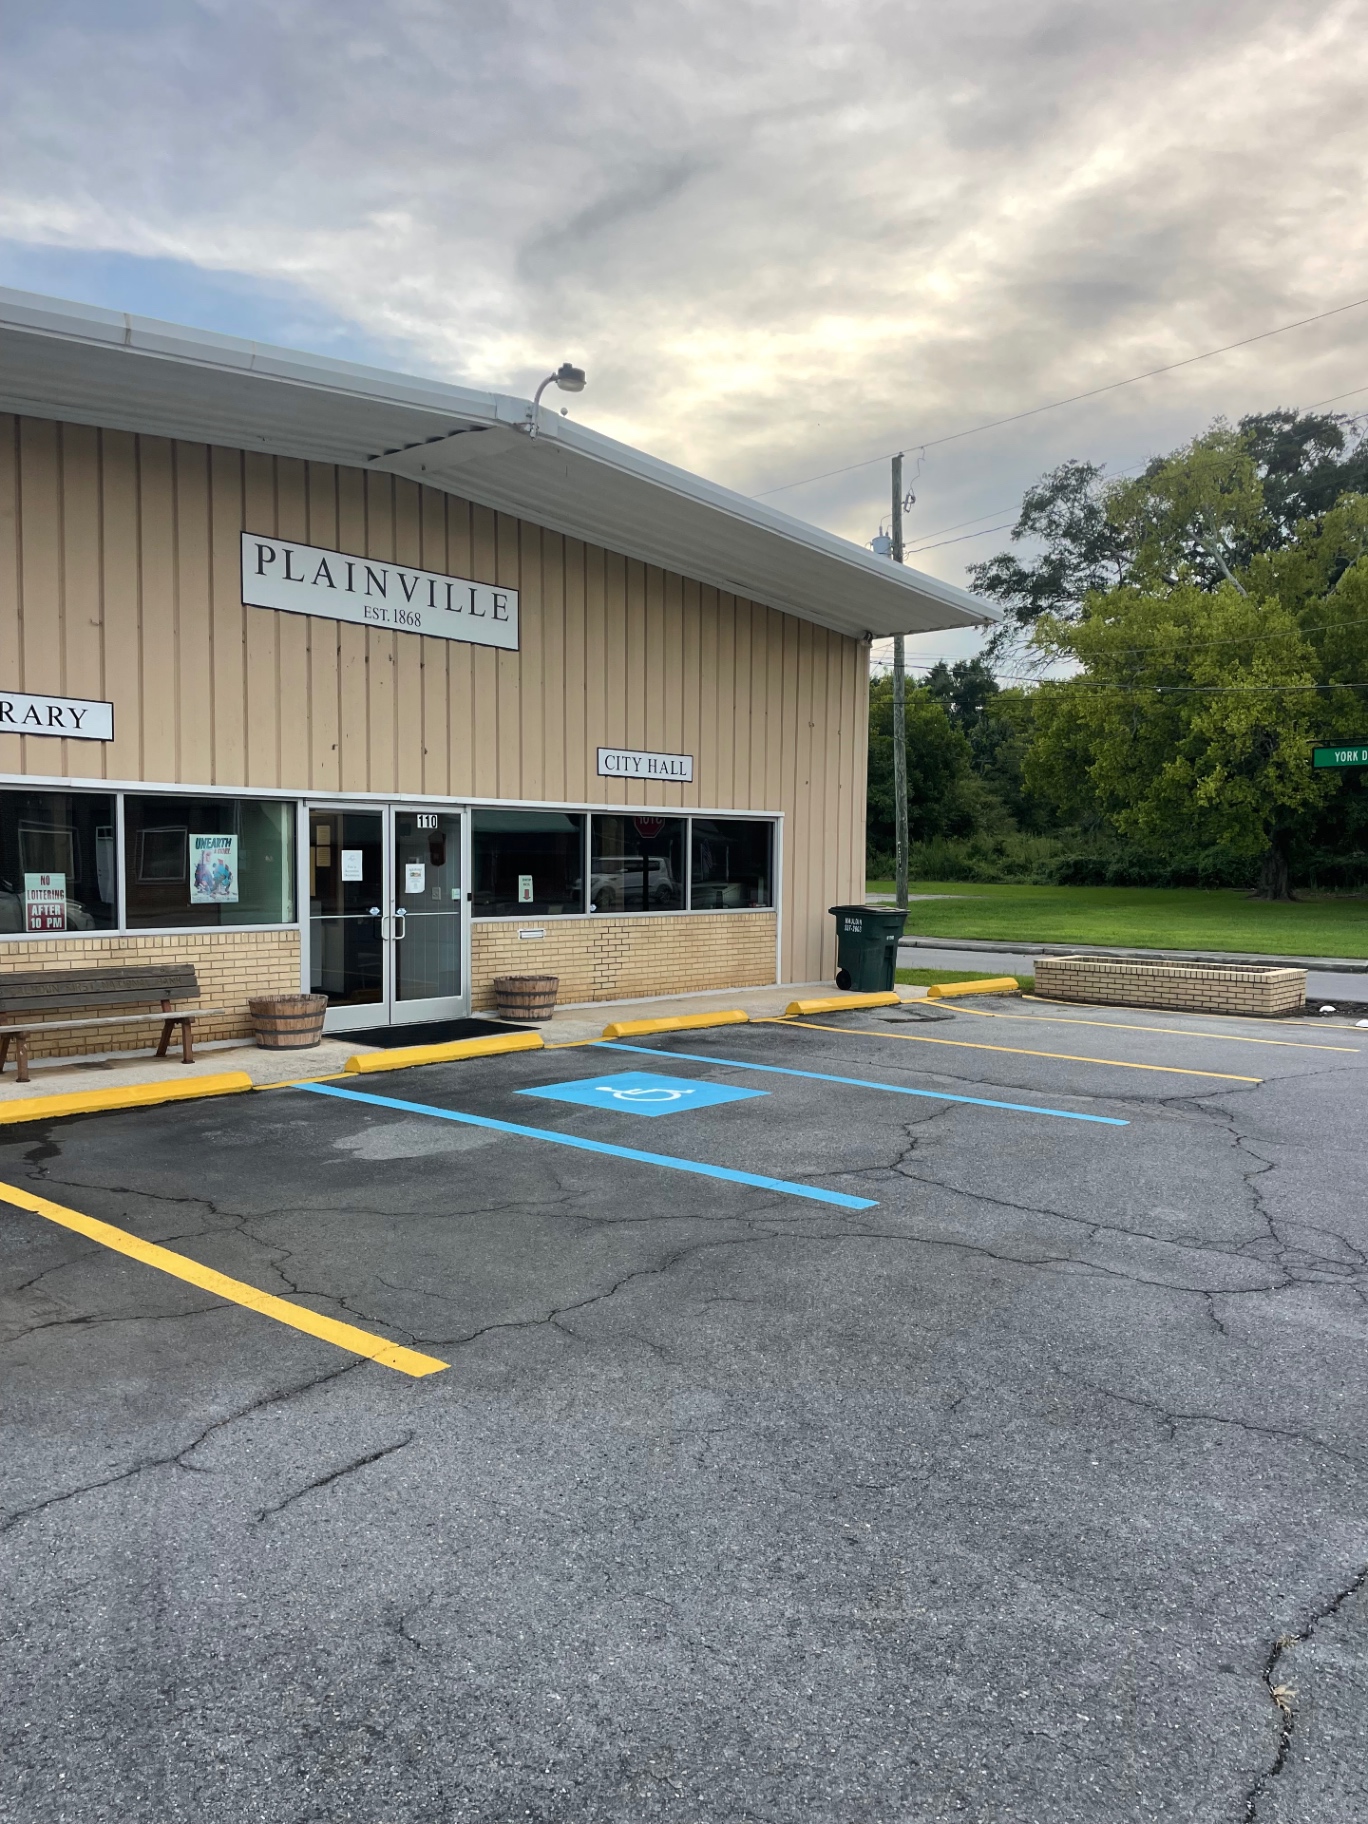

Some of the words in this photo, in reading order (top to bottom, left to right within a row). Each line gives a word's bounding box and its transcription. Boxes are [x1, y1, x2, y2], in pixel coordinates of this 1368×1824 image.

[254, 543, 510, 622] PLAINVILLE
[363, 605, 390, 622] EST.
[393, 610, 422, 627] 1868
[0, 701, 89, 729] RARY
[1334, 750, 1359, 762] YORK
[604, 754, 642, 773] CITY
[647, 758, 687, 776] HALL
[418, 815, 437, 828] 110
[195, 837, 232, 850] UNEARTH
[40, 875, 51, 886] NO
[27, 889, 65, 901] LOITERING
[31, 904, 62, 916] AFTER
[31, 917, 42, 929] 10
[46, 917, 62, 928] PM
